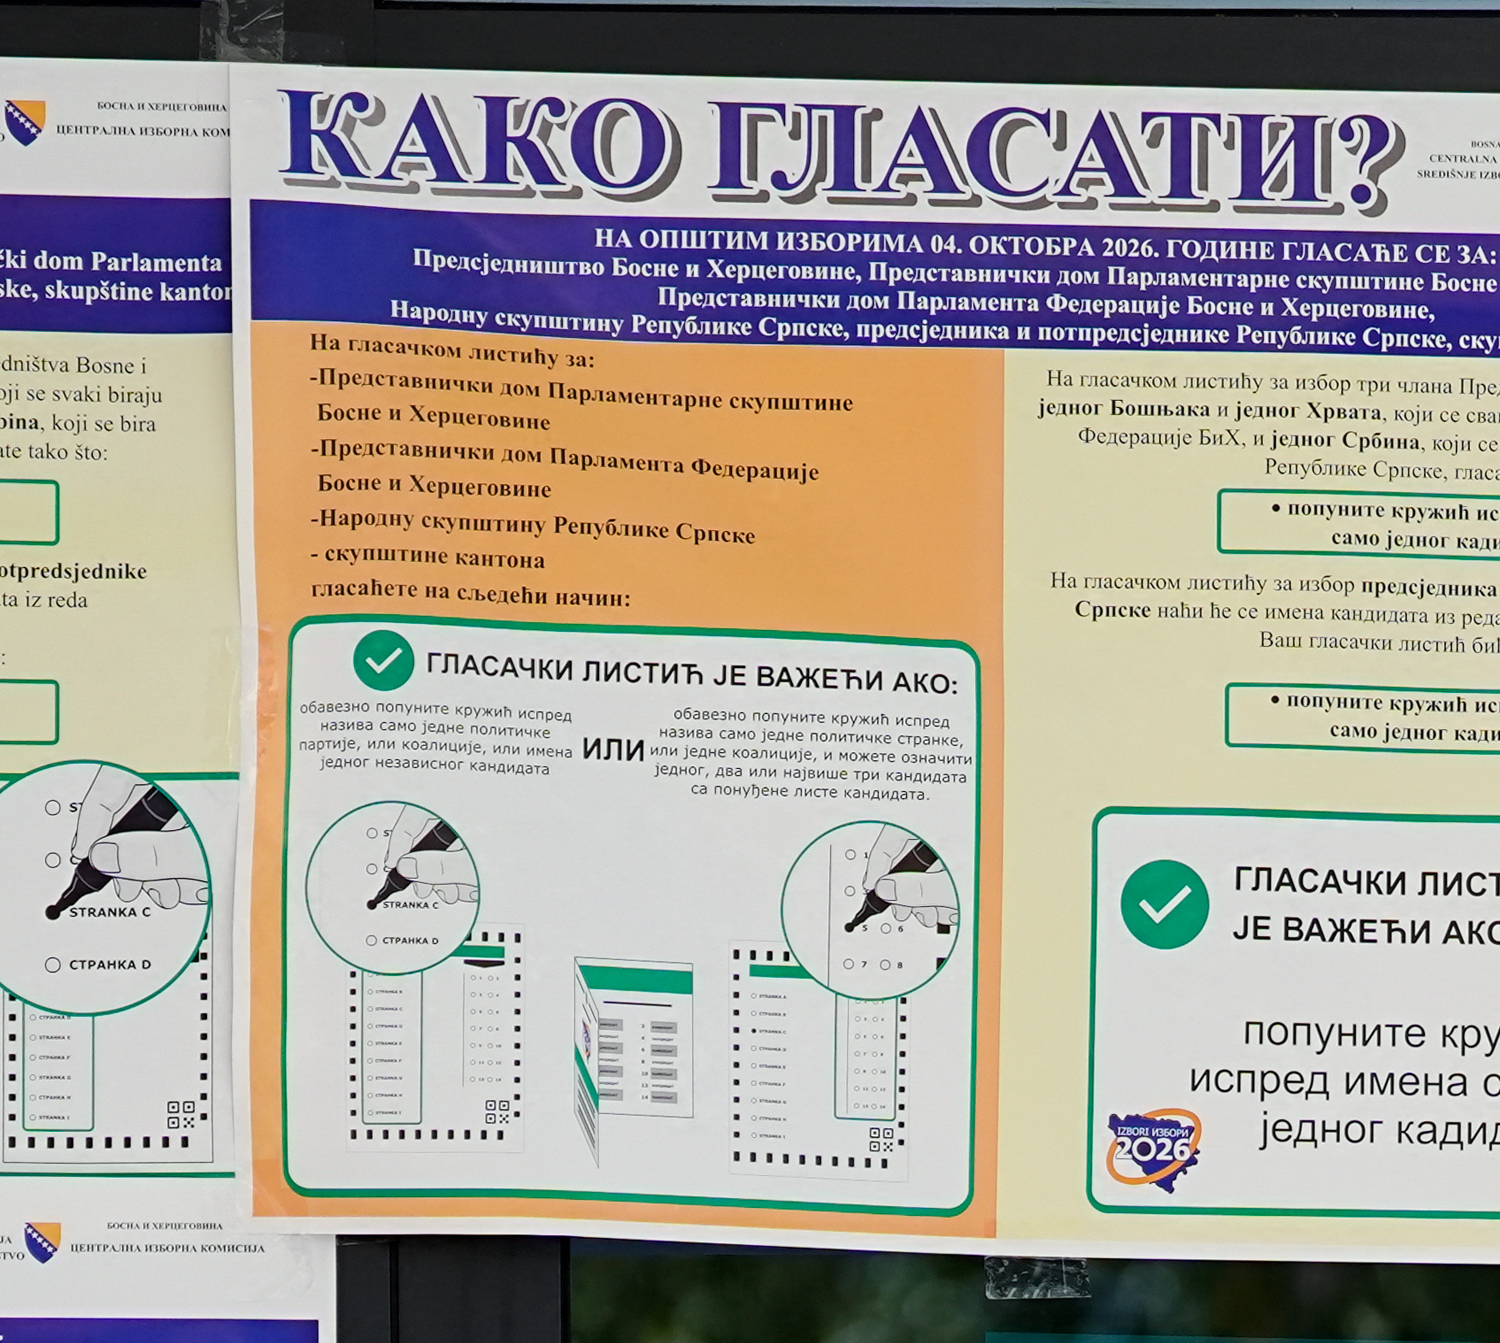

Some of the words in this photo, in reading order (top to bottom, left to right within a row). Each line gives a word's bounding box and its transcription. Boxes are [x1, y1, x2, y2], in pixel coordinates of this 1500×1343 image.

[276, 87, 678, 195] КАКО
[707, 99, 1403, 213] ГЛАСАТИ?
[596, 228, 632, 248] НА
[640, 229, 768, 250] ОПШТИМ
[777, 231, 923, 253] ИЗБОРИМА
[931, 234, 962, 254] 04.
[970, 235, 1095, 256] ОКТОБРА
[1103, 237, 1159, 258] 2026.
[1167, 239, 1274, 263] ГОДИНЕ
[1283, 242, 1408, 263] ГЛАСАЋЕ
[1416, 244, 1450, 264] СЕ
[1458, 245, 1496, 265] ЗА:
[1287, 501, 1385, 522] попуните
[1393, 504, 1468, 524] кружић
[311, 508, 414, 531] -Народну
[422, 515, 546, 538] скупштину
[555, 516, 668, 541] Републике
[676, 523, 755, 545] Српске
[1332, 532, 1379, 545] само
[1385, 530, 1449, 551] једног
[428, 652, 572, 681] ГЛАСАЧКИ
[583, 661, 703, 685] ЛИСТИЋ
[714, 664, 746, 687] ЈЕ
[758, 665, 882, 691] ВАЖЕЋИ
[893, 672, 957, 695] АКО:
[300, 700, 369, 714] обавезно
[376, 702, 449, 716] попуните
[456, 705, 511, 719] кружић
[519, 710, 572, 724] испред
[583, 737, 645, 762] ИЛИ
[1236, 866, 1405, 895] ГЛАСАЧКИ
[1233, 915, 1271, 941] ЈЕ
[1284, 916, 1430, 944] ВАЖЕЋИ
[1118, 1127, 1149, 1136] IZBORI
[1152, 1128, 1188, 1137] ИЗБОРИ
[1115, 1136, 1191, 1161] 2026
[70, 1244, 141, 1253] ЦЕНТРАЛНА
[145, 1244, 197, 1253] ИЗБОРНА
[201, 1244, 265, 1253] КОМИСИЈА
